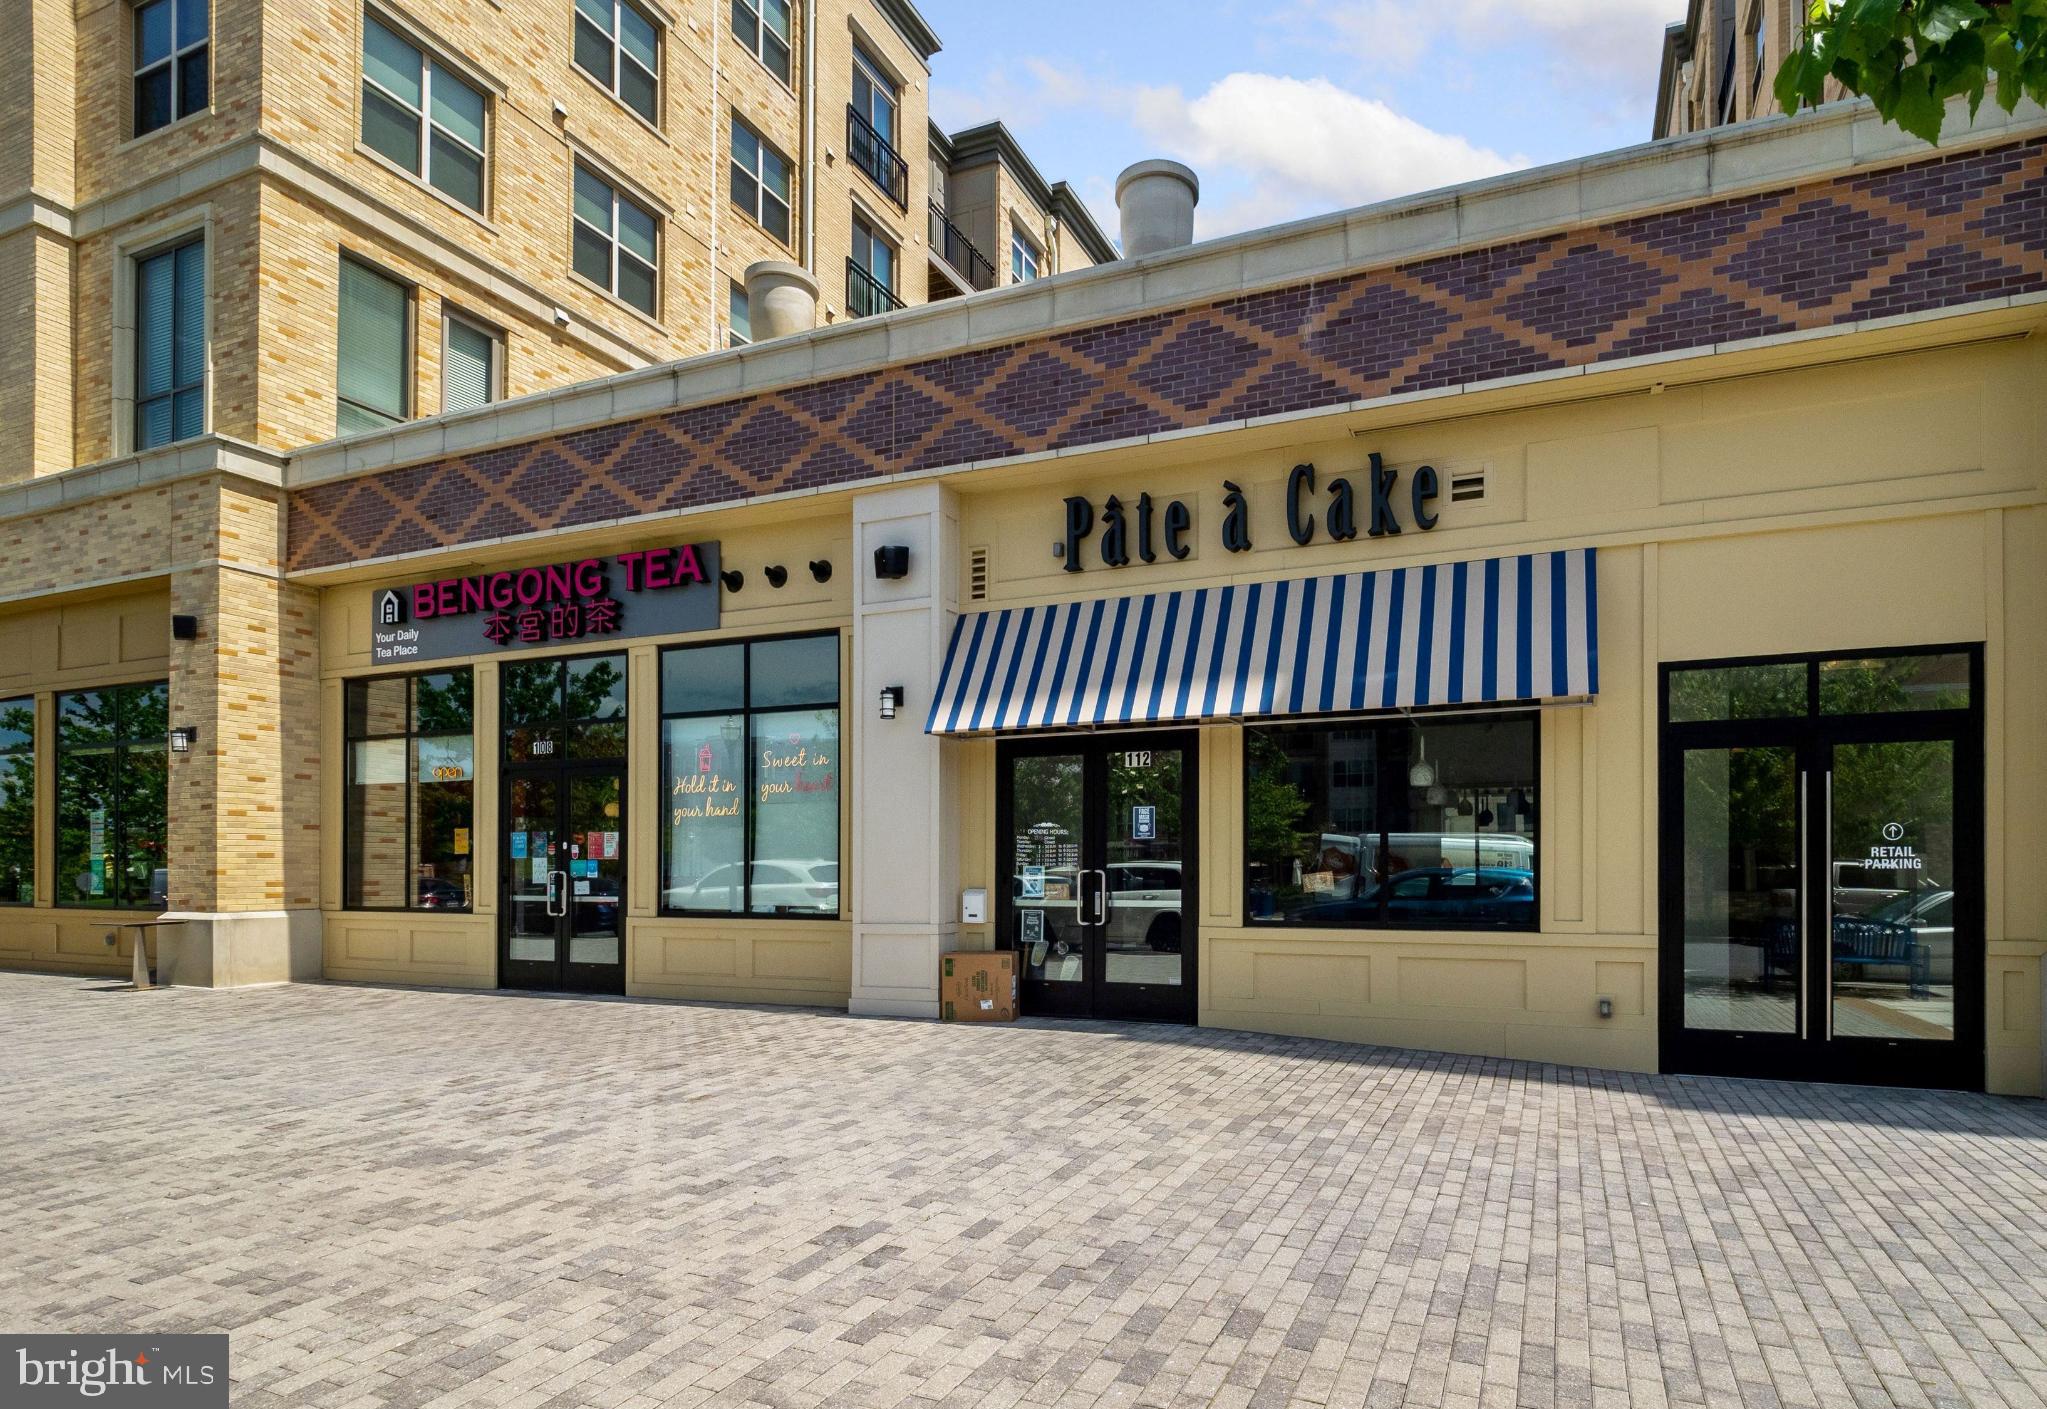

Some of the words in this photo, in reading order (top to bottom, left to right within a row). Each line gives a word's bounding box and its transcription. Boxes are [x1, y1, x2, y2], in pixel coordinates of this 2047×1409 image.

[1062, 491, 1191, 572] Pâte
[1221, 479, 1253, 553] à
[1286, 452, 1440, 546] Cake
[412, 558, 603, 619] BENGONG
[617, 544, 704, 591] TEA
[375, 632, 396, 644] Your
[397, 628, 420, 642] Daily
[375, 647, 392, 658] Tea
[393, 645, 418, 656] Place
[533, 741, 553, 755] 108
[761, 747, 807, 768] Sweet
[812, 753, 830, 766] in
[1127, 751, 1150, 767] 112
[432, 766, 463, 780] open
[673, 774, 706, 796] Hold
[708, 774, 720, 793] it
[721, 779, 737, 793] in
[761, 781, 793, 802] your
[674, 805, 703, 826] your
[705, 796, 740, 817] hand
[1870, 846, 1916, 857] RETAIL
[1864, 858, 1922, 869] PARKING
